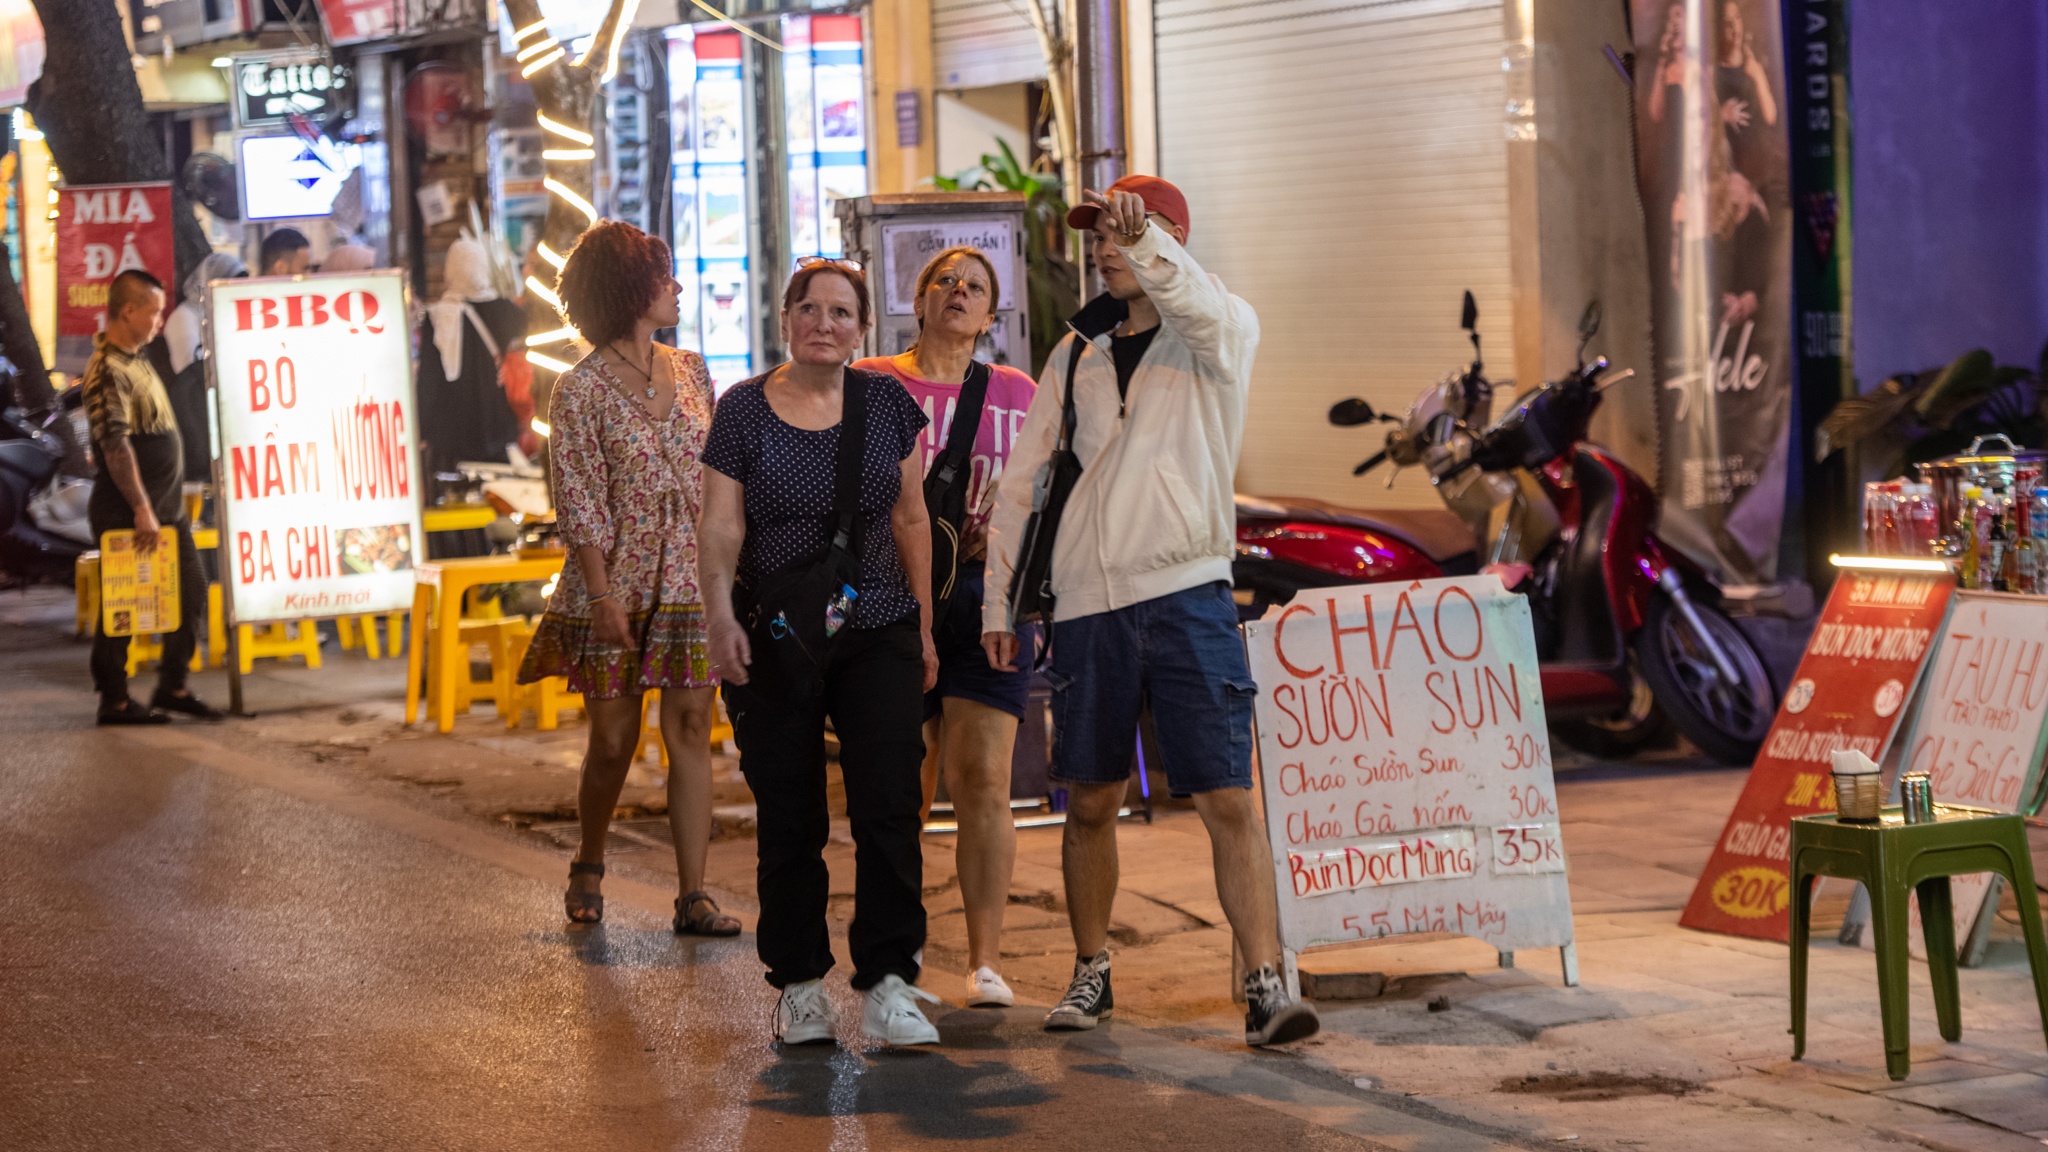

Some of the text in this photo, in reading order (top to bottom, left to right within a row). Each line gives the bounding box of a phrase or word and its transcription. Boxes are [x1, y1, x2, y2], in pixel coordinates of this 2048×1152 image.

[84, 231, 149, 280] ĐÁ
[230, 290, 385, 335] BBQ
[248, 341, 297, 413] BÒ
[236, 529, 276, 585] BA
[1273, 579, 1483, 680] CHÁO
[1272, 662, 1523, 750] SƯỜN SỤN
[1280, 755, 1346, 797] Cháo
[1353, 749, 1414, 787] Sườn
[1286, 803, 1343, 846] Cháo
[1354, 800, 1397, 837] Gà
[1289, 852, 1343, 897] Bún
[1344, 847, 1400, 888] Dọc
[1719, 874, 1789, 914] 30K
